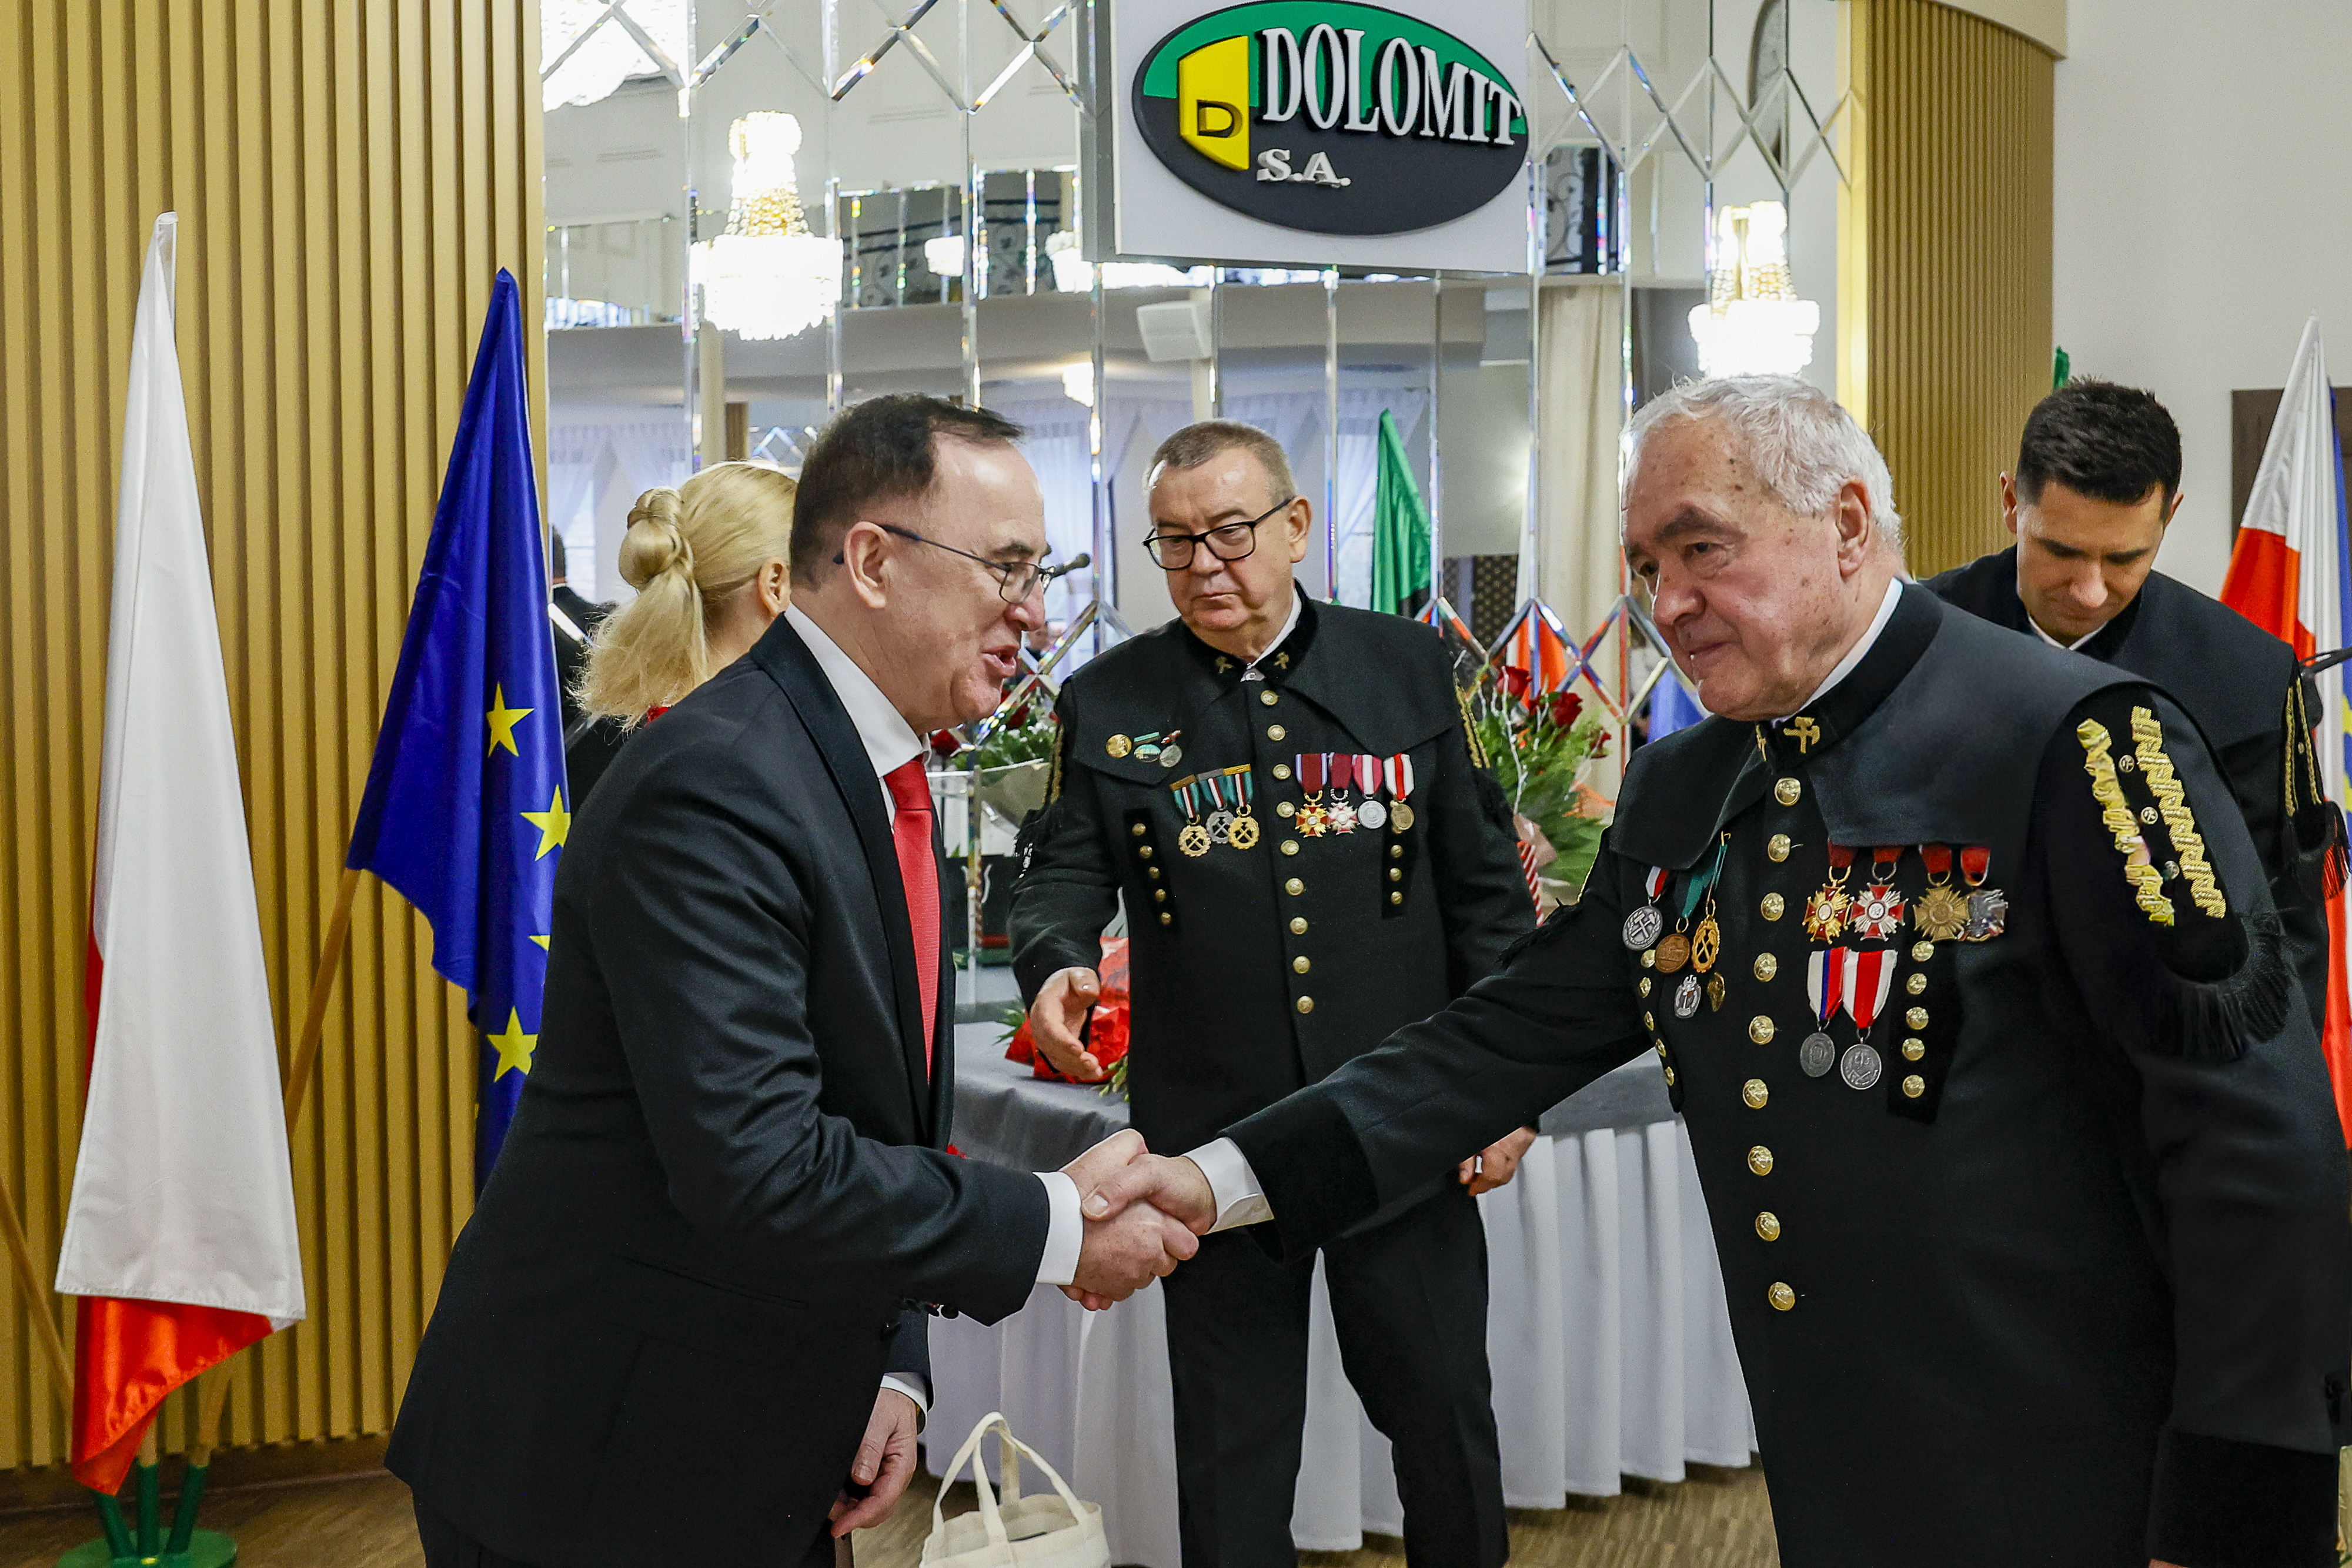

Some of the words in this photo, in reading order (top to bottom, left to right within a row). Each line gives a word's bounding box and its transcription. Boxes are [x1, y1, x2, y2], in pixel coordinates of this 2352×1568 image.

[1262, 23, 1522, 146] DOLOMIT
[1197, 100, 1242, 138] D
[1257, 148, 1351, 188] S.A.
